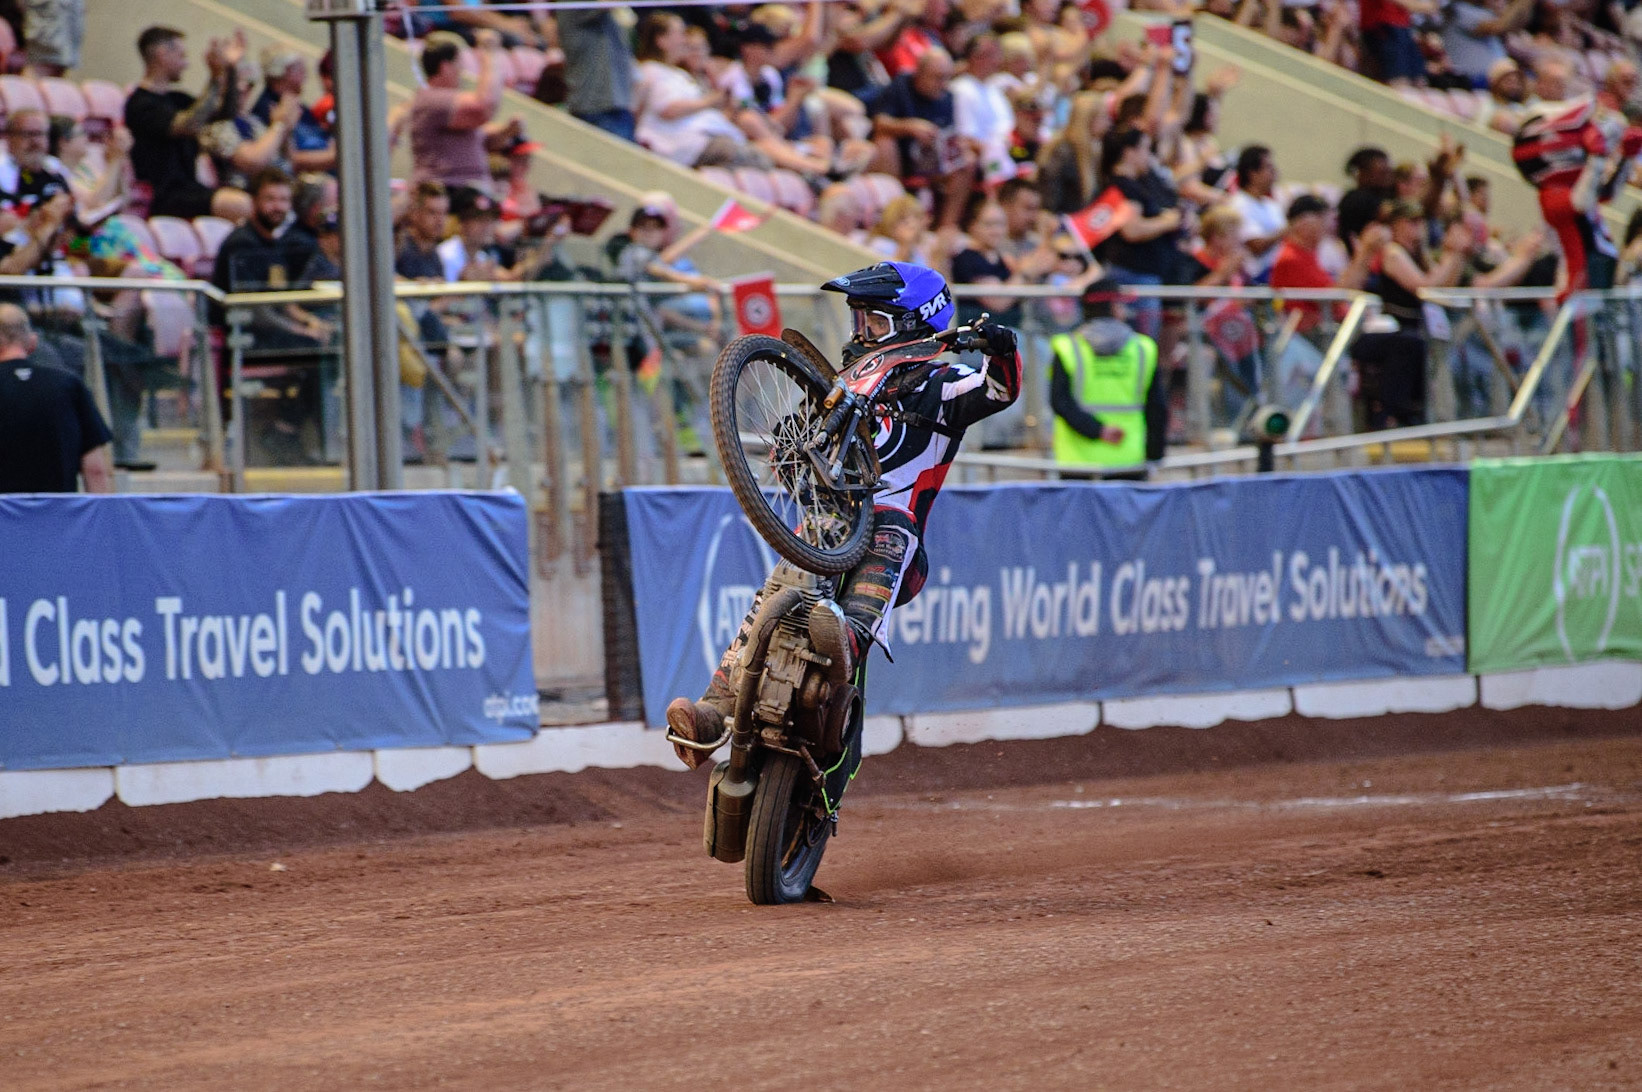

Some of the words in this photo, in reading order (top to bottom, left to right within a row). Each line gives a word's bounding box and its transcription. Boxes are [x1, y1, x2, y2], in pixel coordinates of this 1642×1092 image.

[24, 595, 146, 687] Class
[155, 589, 289, 680] Travel
[301, 586, 486, 676] Solutions
[1001, 561, 1102, 639] World
[1111, 557, 1191, 635] Class
[1197, 551, 1283, 630] Travel
[1290, 546, 1428, 622] Solutions
